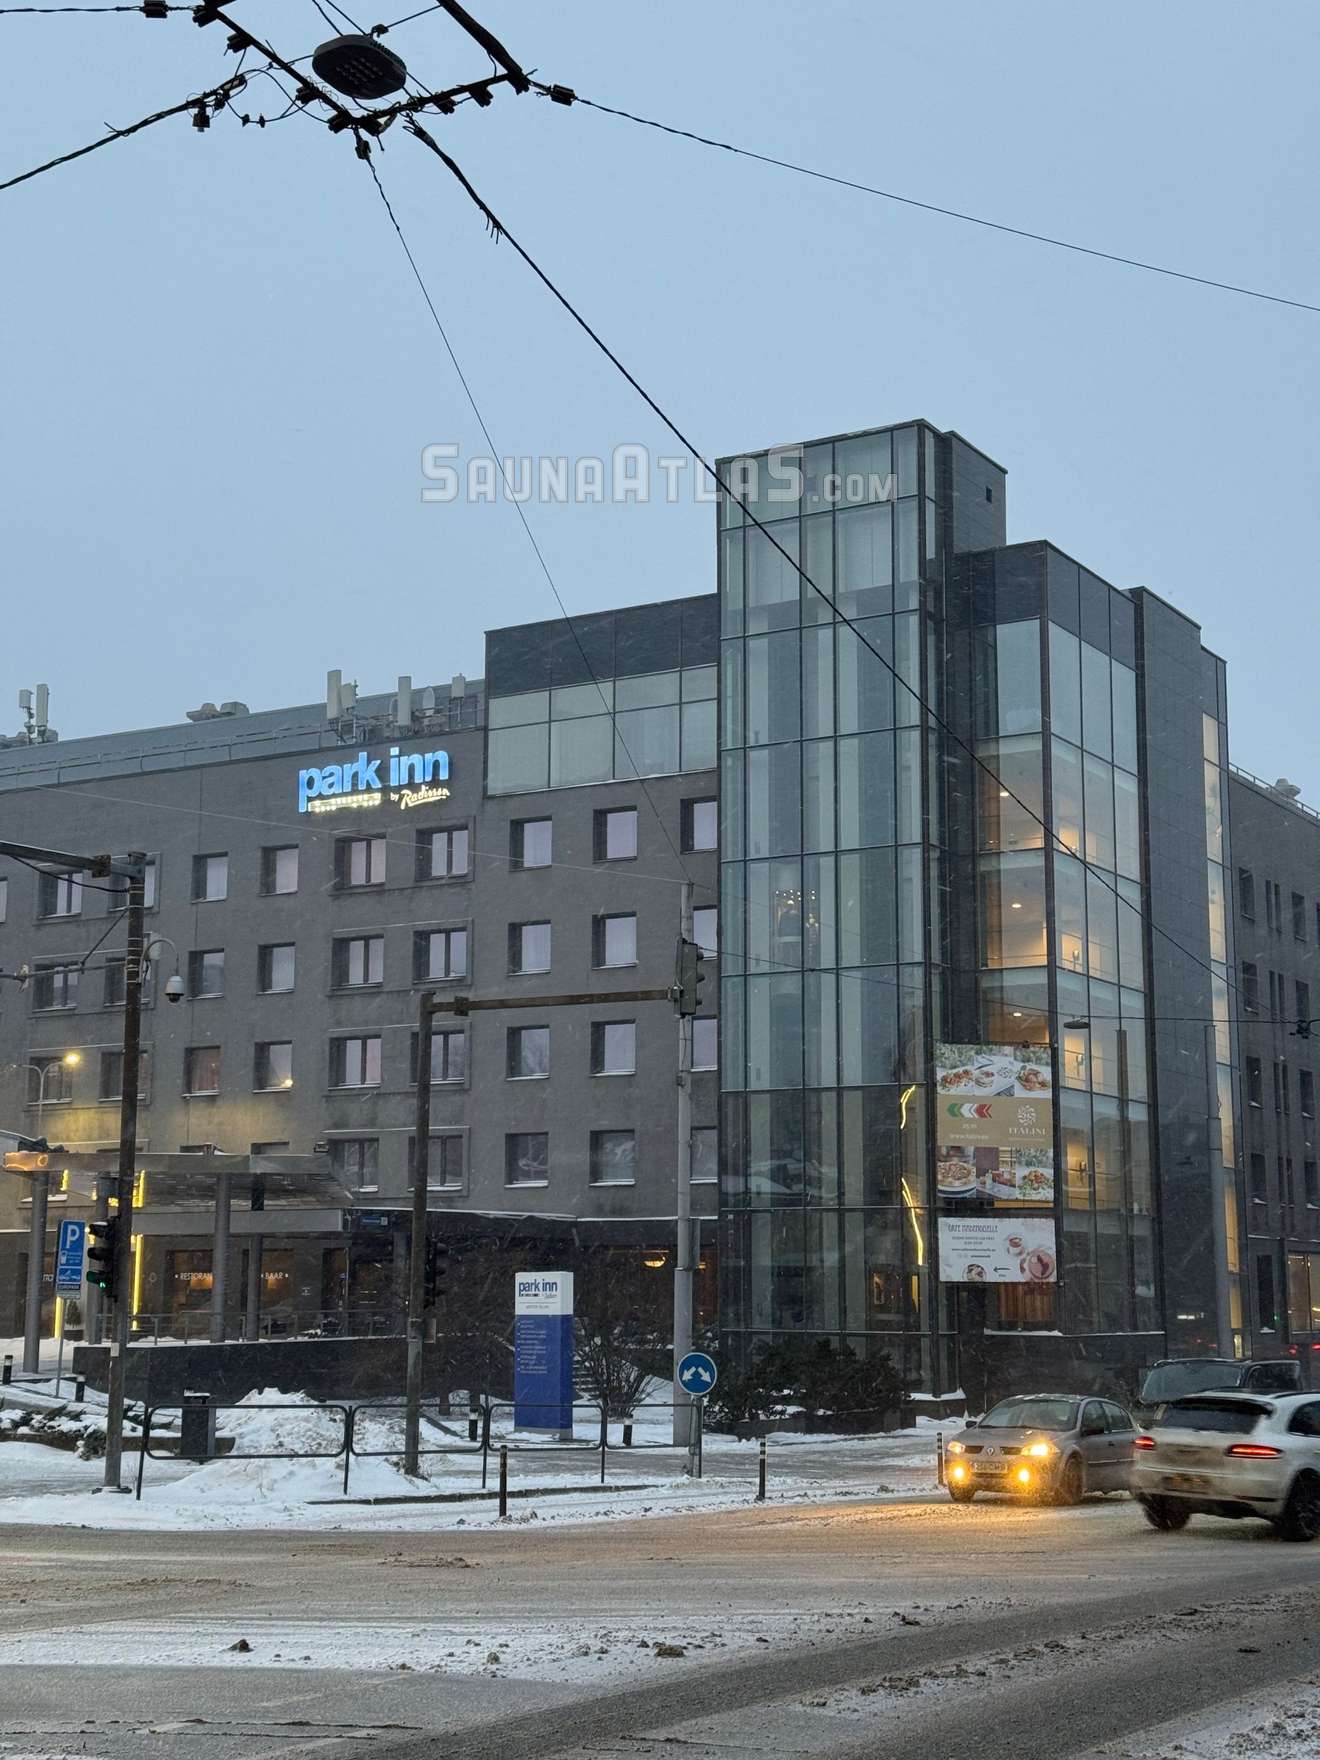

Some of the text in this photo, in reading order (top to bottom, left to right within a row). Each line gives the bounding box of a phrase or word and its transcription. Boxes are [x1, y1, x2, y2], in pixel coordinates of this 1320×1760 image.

[299, 747, 449, 812] park inn
[390, 785, 450, 810] by Radisson
[66, 1224, 80, 1249] P
[265, 1271, 284, 1280] BAAR
[519, 1278, 540, 1297] park
[542, 1278, 558, 1292] inn
